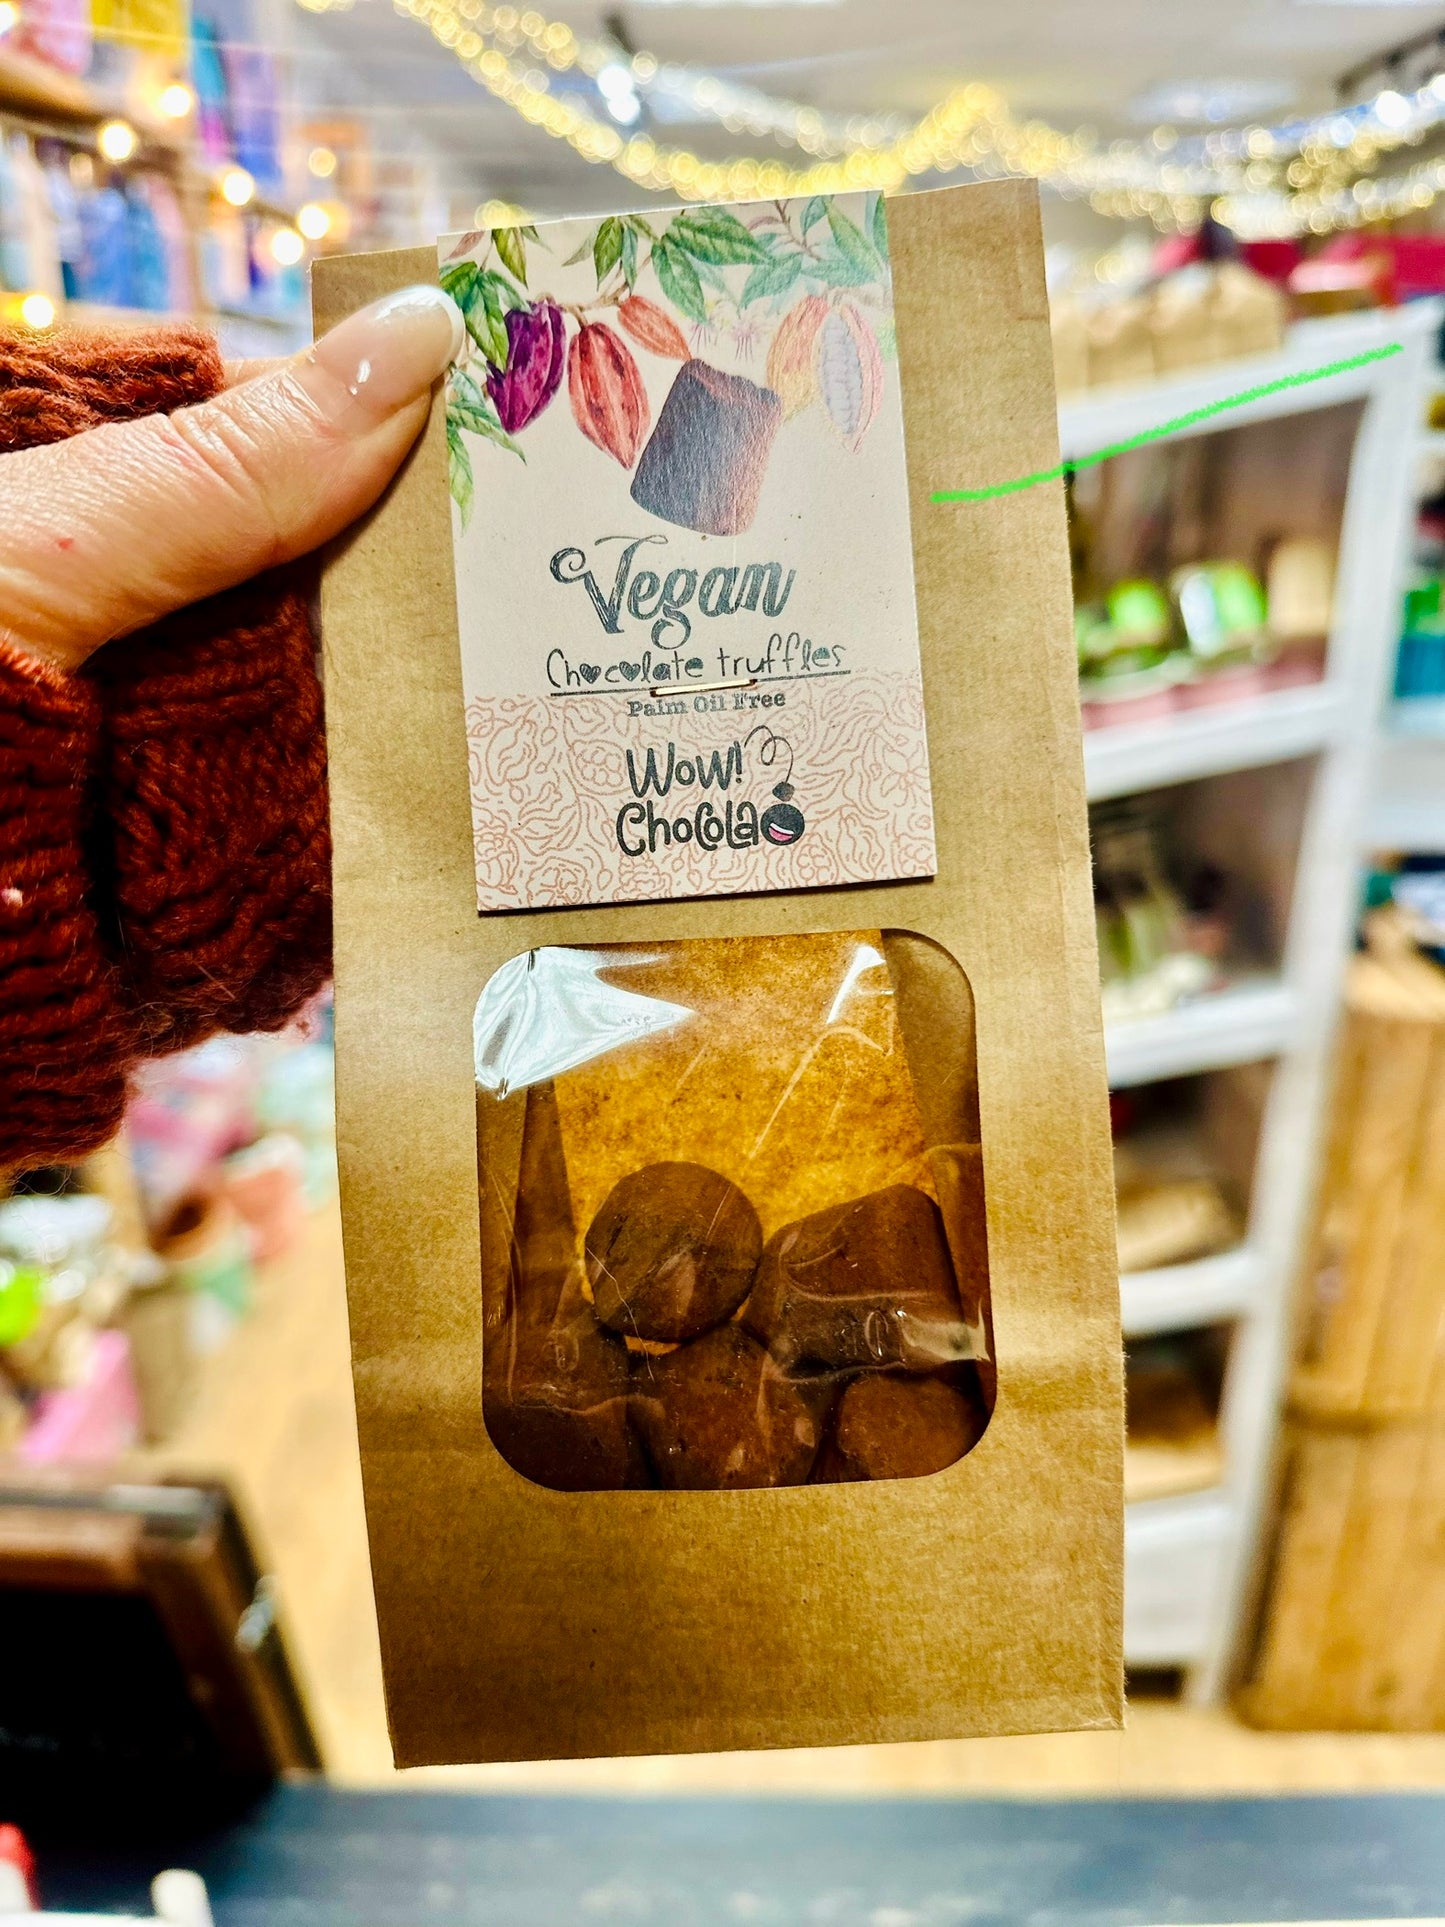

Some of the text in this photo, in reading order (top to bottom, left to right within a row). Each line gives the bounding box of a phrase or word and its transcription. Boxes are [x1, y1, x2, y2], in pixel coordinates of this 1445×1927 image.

[549, 534, 796, 649] Vegan
[546, 632, 846, 688] Chocolate truffles
[627, 691, 786, 717] Palm Oil Free
